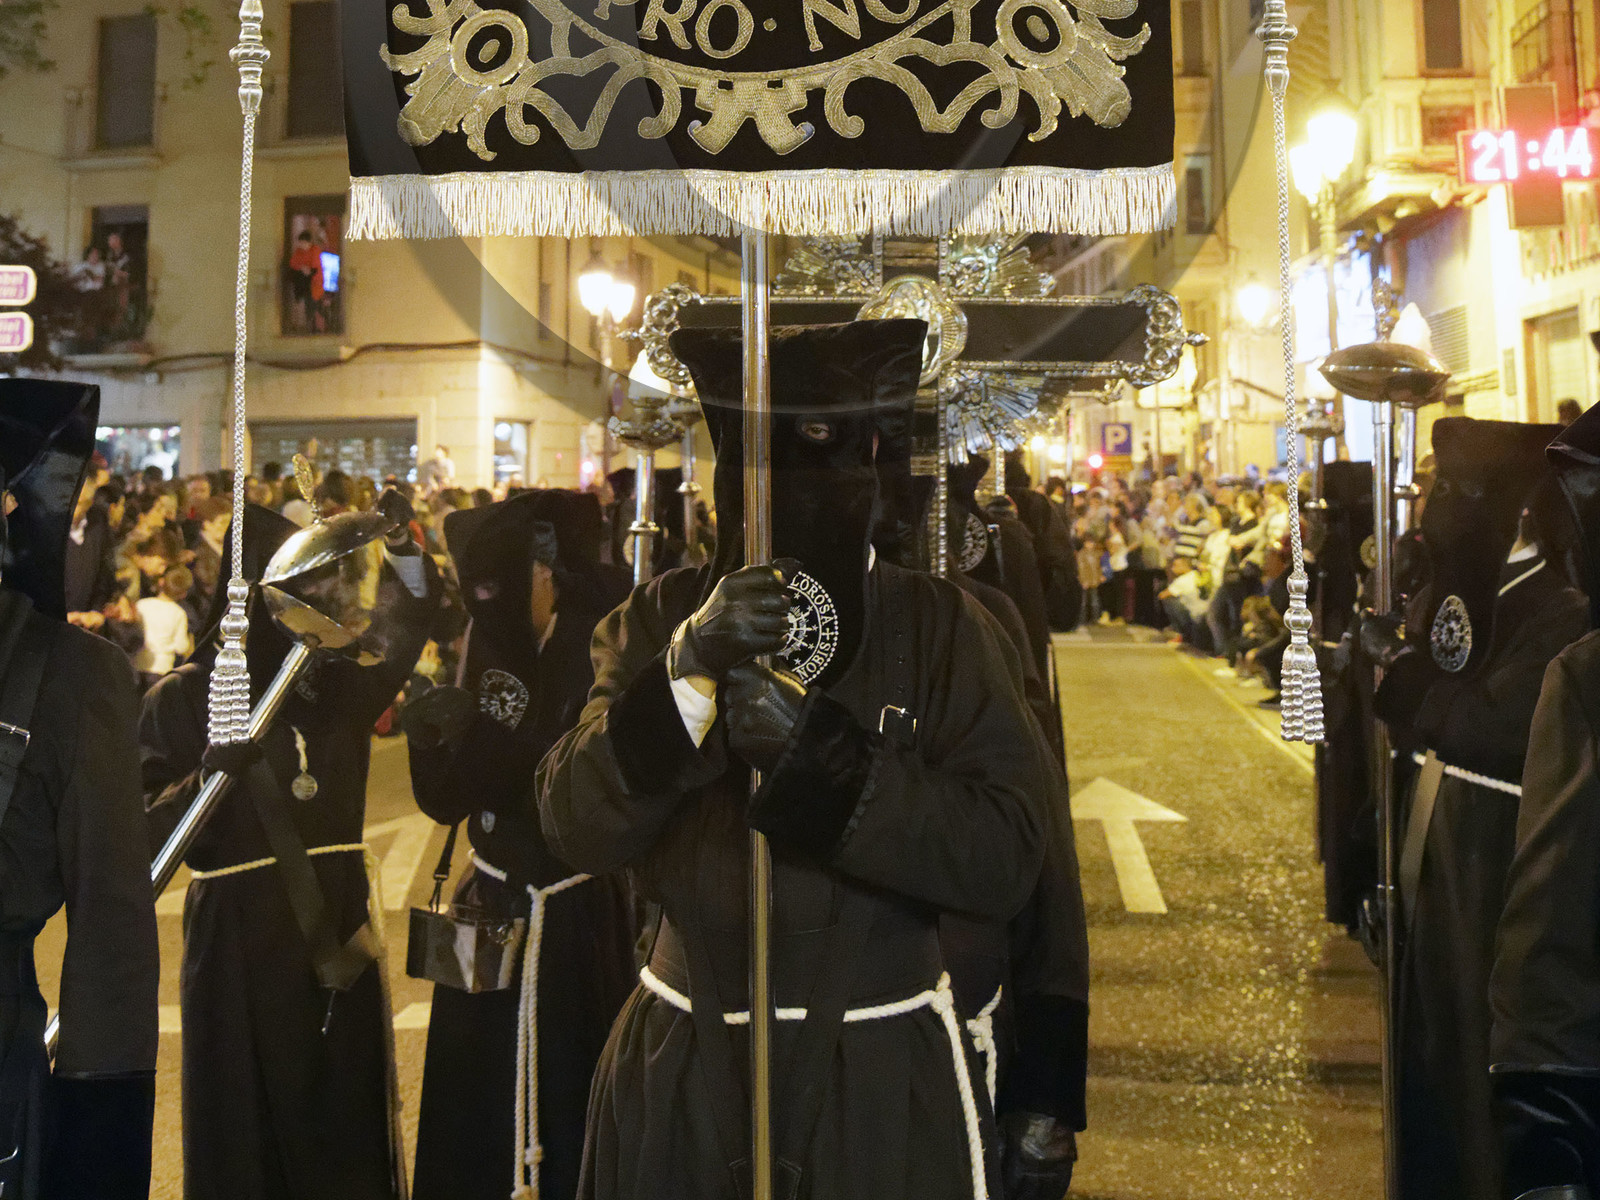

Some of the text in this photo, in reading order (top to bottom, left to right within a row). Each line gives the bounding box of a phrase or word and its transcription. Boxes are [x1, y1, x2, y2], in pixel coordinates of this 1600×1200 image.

[1471, 126, 1593, 182] 21:44
[1105, 425, 1128, 452] P
[796, 641, 832, 681] NOBIS
